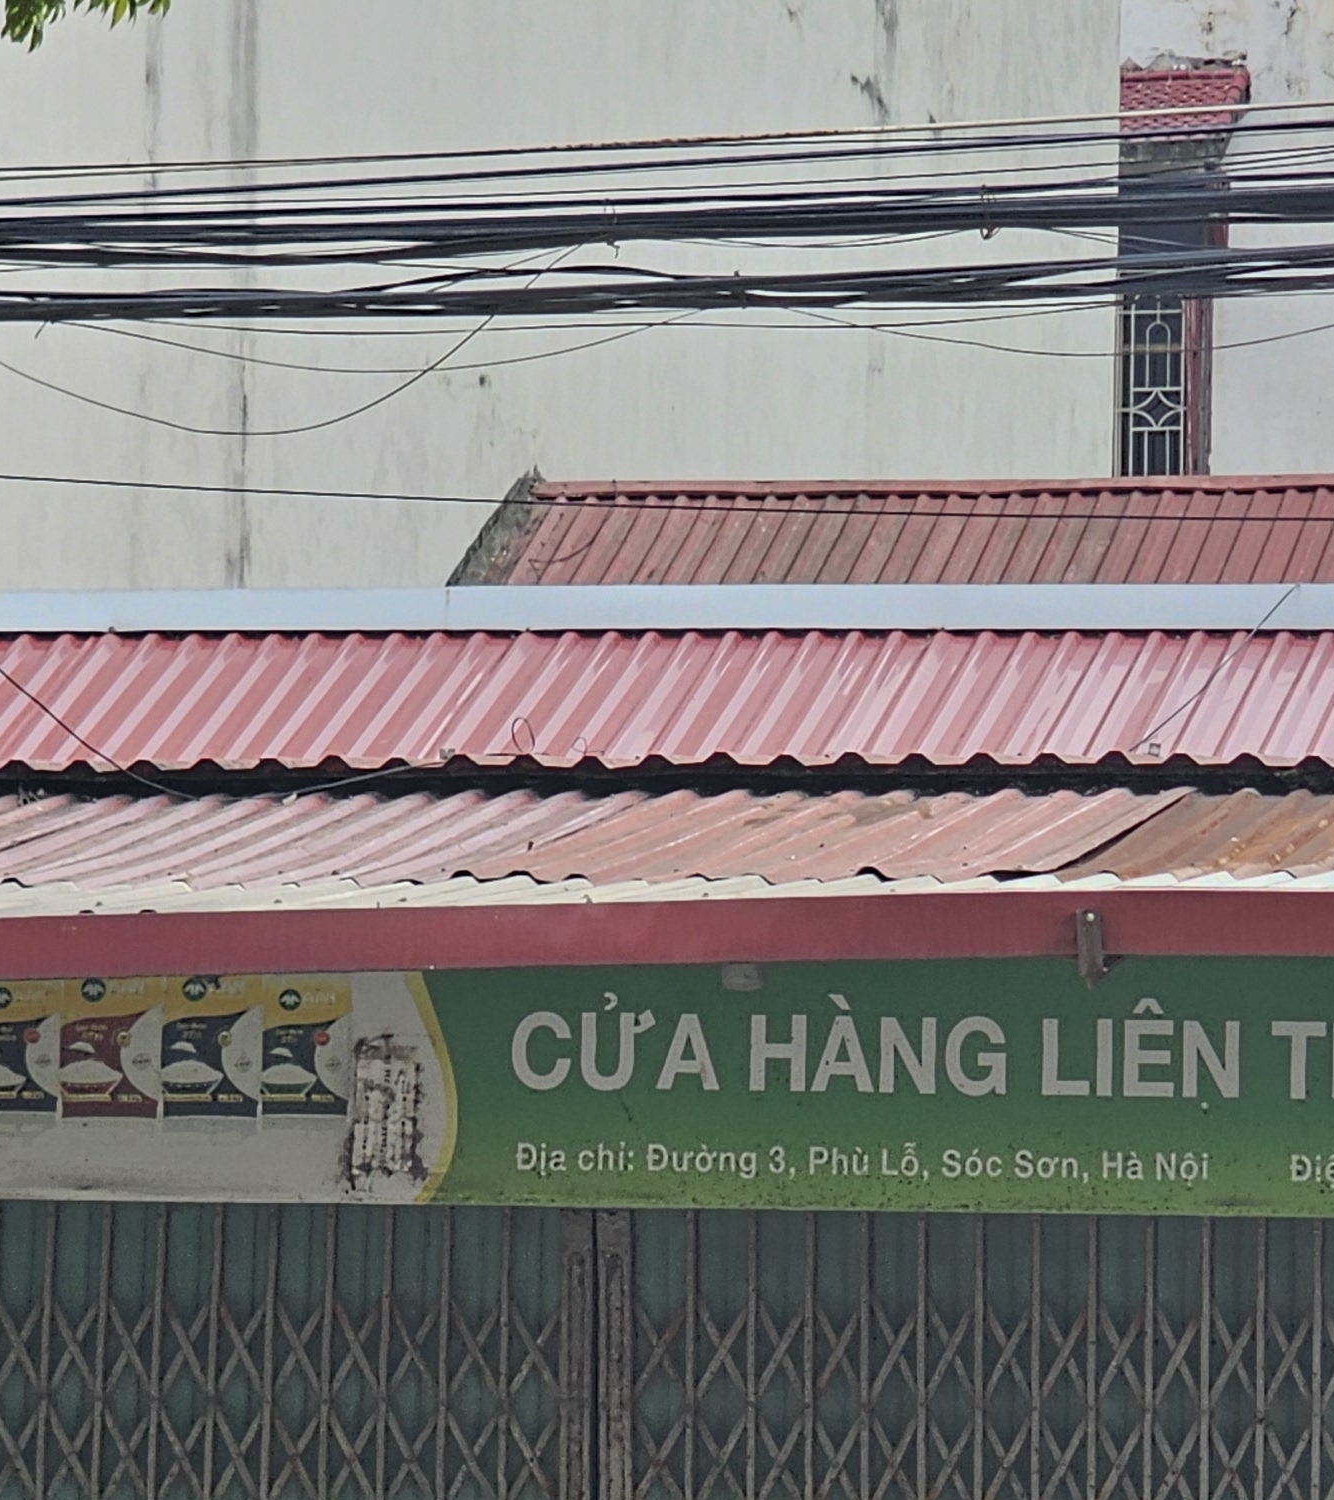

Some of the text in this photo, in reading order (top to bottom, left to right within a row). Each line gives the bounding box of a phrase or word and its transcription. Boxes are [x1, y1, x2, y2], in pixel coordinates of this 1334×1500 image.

[512, 992, 720, 1091] CỬA
[749, 994, 1007, 1095] HÀNG
[1041, 997, 1240, 1098] LIÊN
[515, 1142, 566, 1175] Địa
[577, 1141, 633, 1172] chỉ:
[647, 1142, 758, 1179] Đường
[769, 1146, 795, 1176] 3,
[881, 1143, 929, 1181] Lỗ,
[941, 1144, 1002, 1177] Sóc
[1014, 1150, 1089, 1184] Sơn,
[1102, 1151, 1143, 1180] Hà
[1155, 1153, 1209, 1187] Nội
